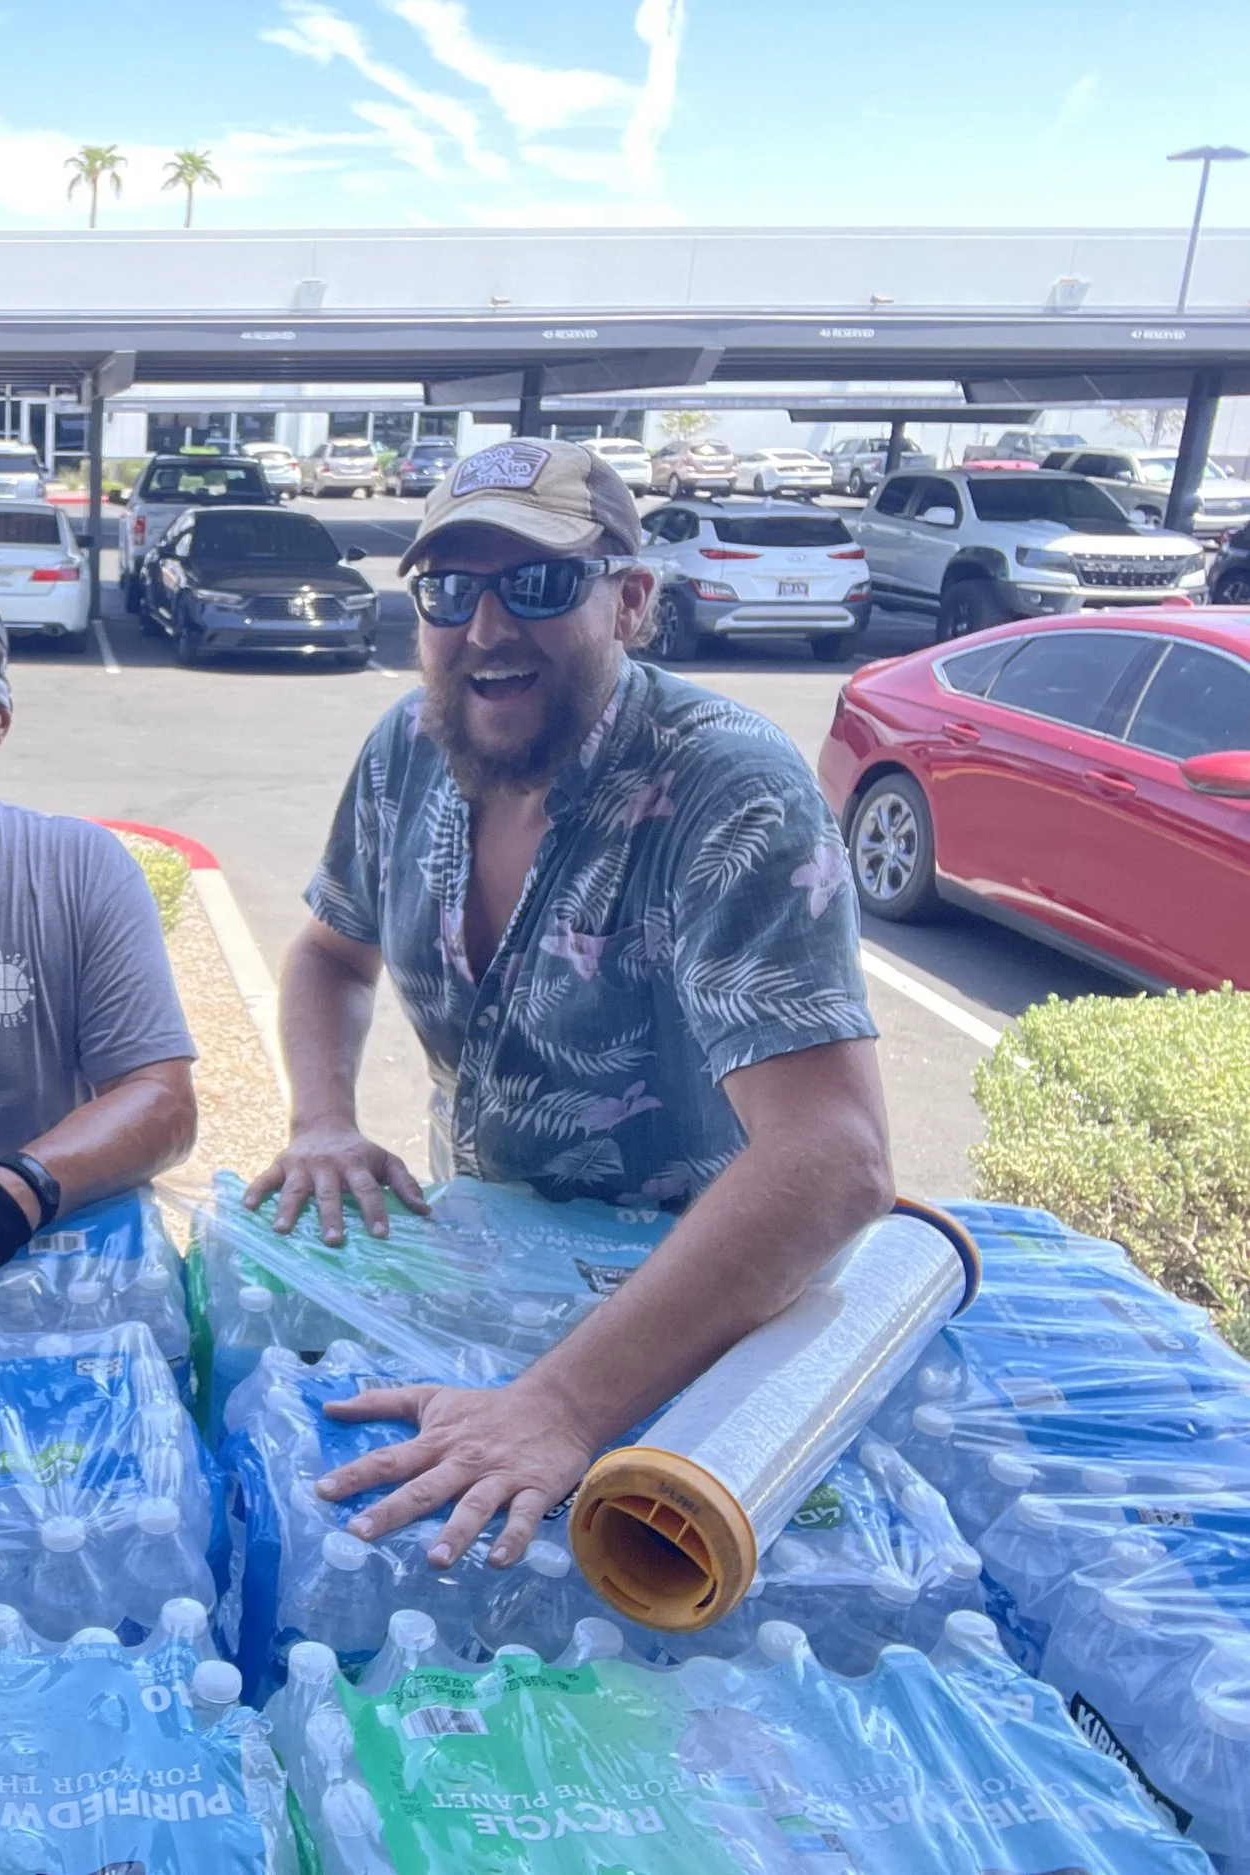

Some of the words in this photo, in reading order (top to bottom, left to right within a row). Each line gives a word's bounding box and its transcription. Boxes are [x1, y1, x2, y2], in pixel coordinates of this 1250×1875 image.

[253, 331, 296, 340] RESERVED
[555, 330, 598, 339] RESERVED
[832, 329, 874, 338] RESERVED
[1143, 330, 1186, 339] RESERVED
[791, 1506, 841, 1525] 40
[51, 1766, 138, 1795] YOUR
[144, 1763, 203, 1787] FOR
[554, 1783, 616, 1804] THE
[620, 1774, 685, 1800] FOR
[47, 1783, 232, 1829] PURIFIED
[432, 1790, 547, 1811] PLANET
[468, 1800, 667, 1841] RECYCLE
